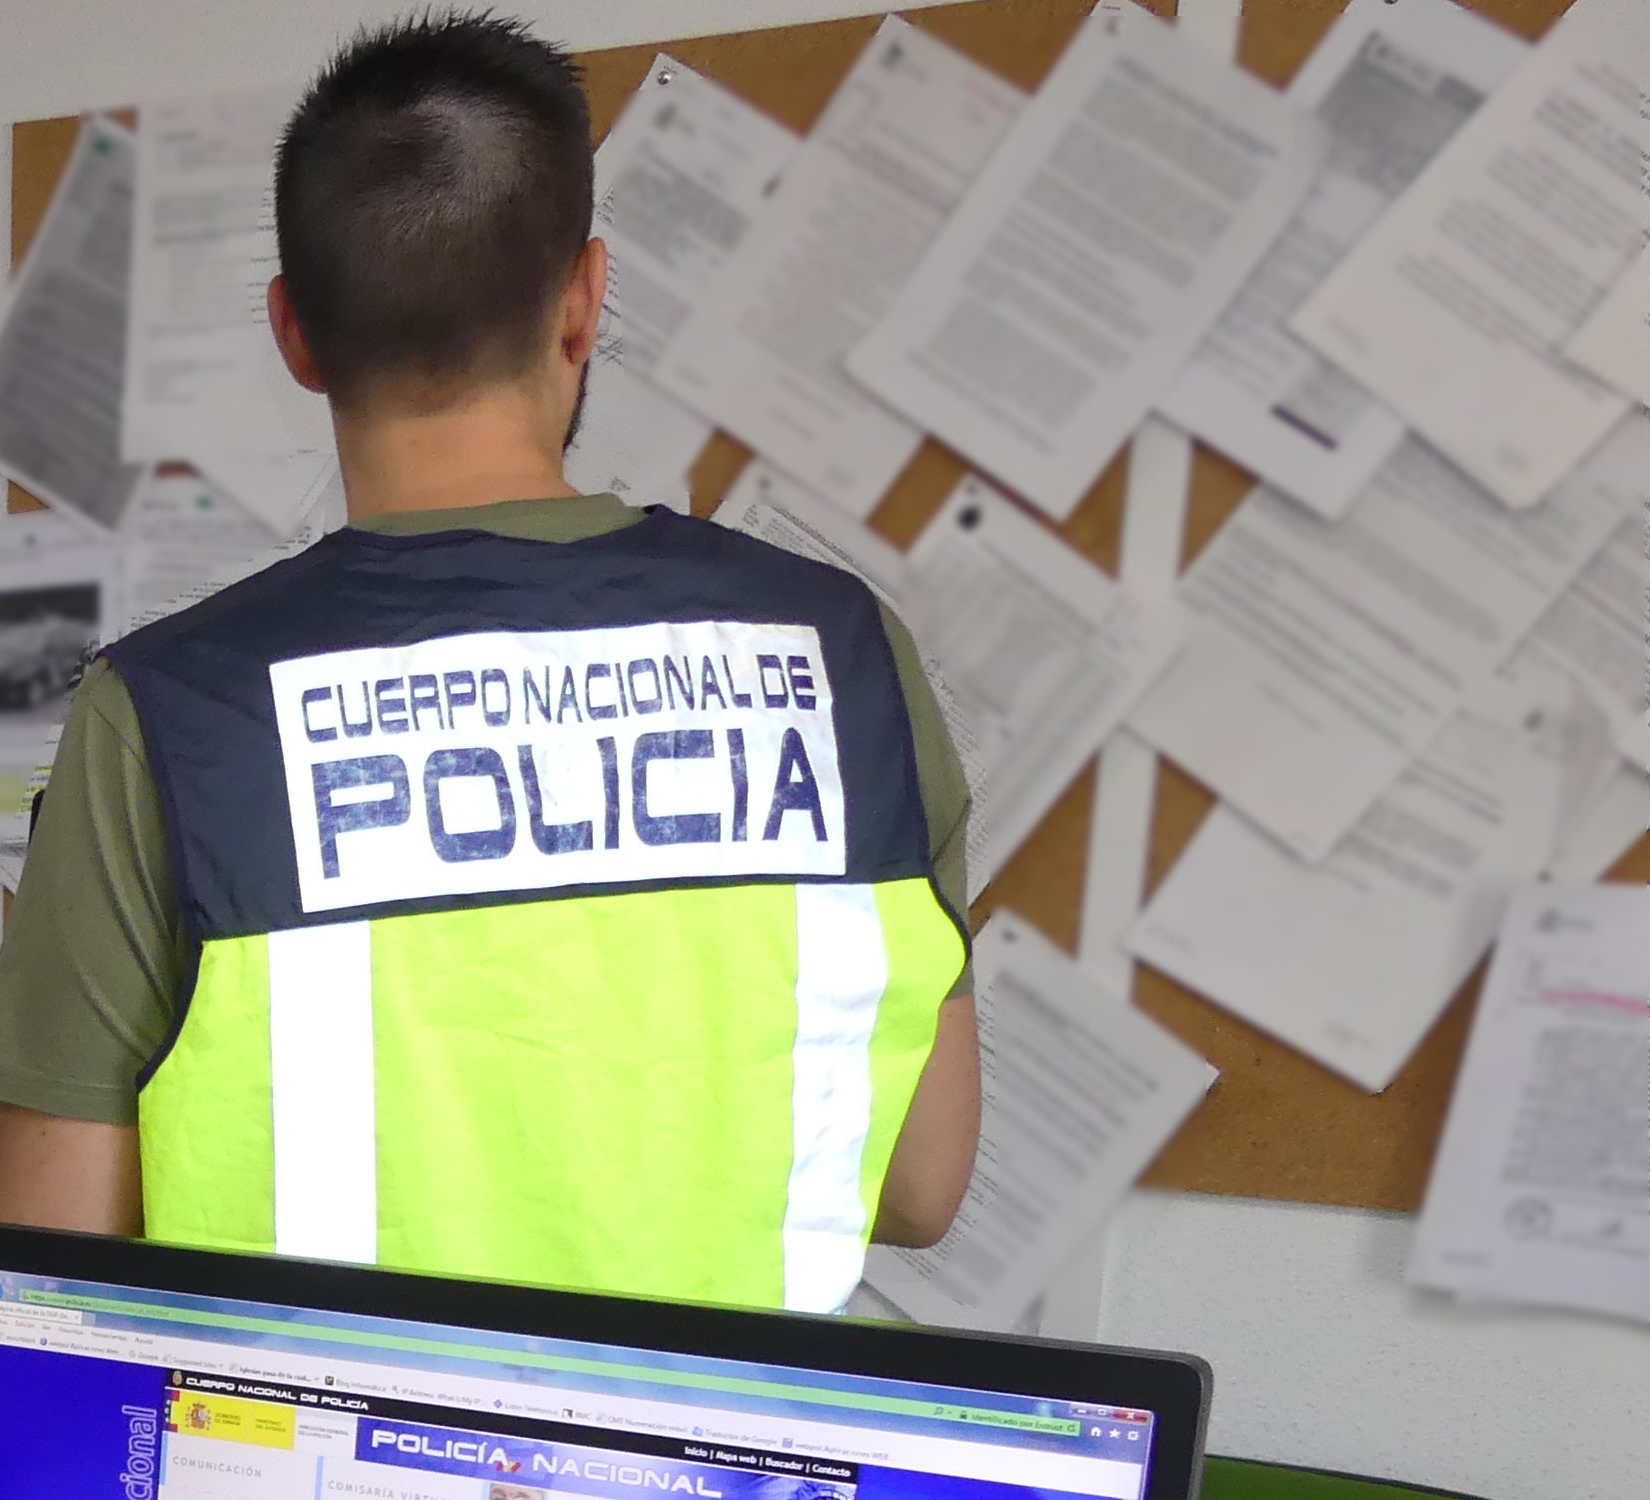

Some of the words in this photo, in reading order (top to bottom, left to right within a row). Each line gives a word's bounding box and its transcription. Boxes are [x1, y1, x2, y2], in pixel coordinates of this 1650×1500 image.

[302, 668, 512, 744] CUERPO
[523, 653, 751, 726] NACIONAL
[756, 654, 817, 712] DE
[311, 727, 829, 880] POLICIA
[186, 1377, 236, 1392] CUERPO
[238, 1385, 297, 1401] NACIONAL
[300, 1393, 318, 1404] DE
[172, 1456, 262, 1478] COMUNICACIÓN
[372, 1429, 510, 1467] POLICÍA
[532, 1455, 723, 1499] NACIONAL
